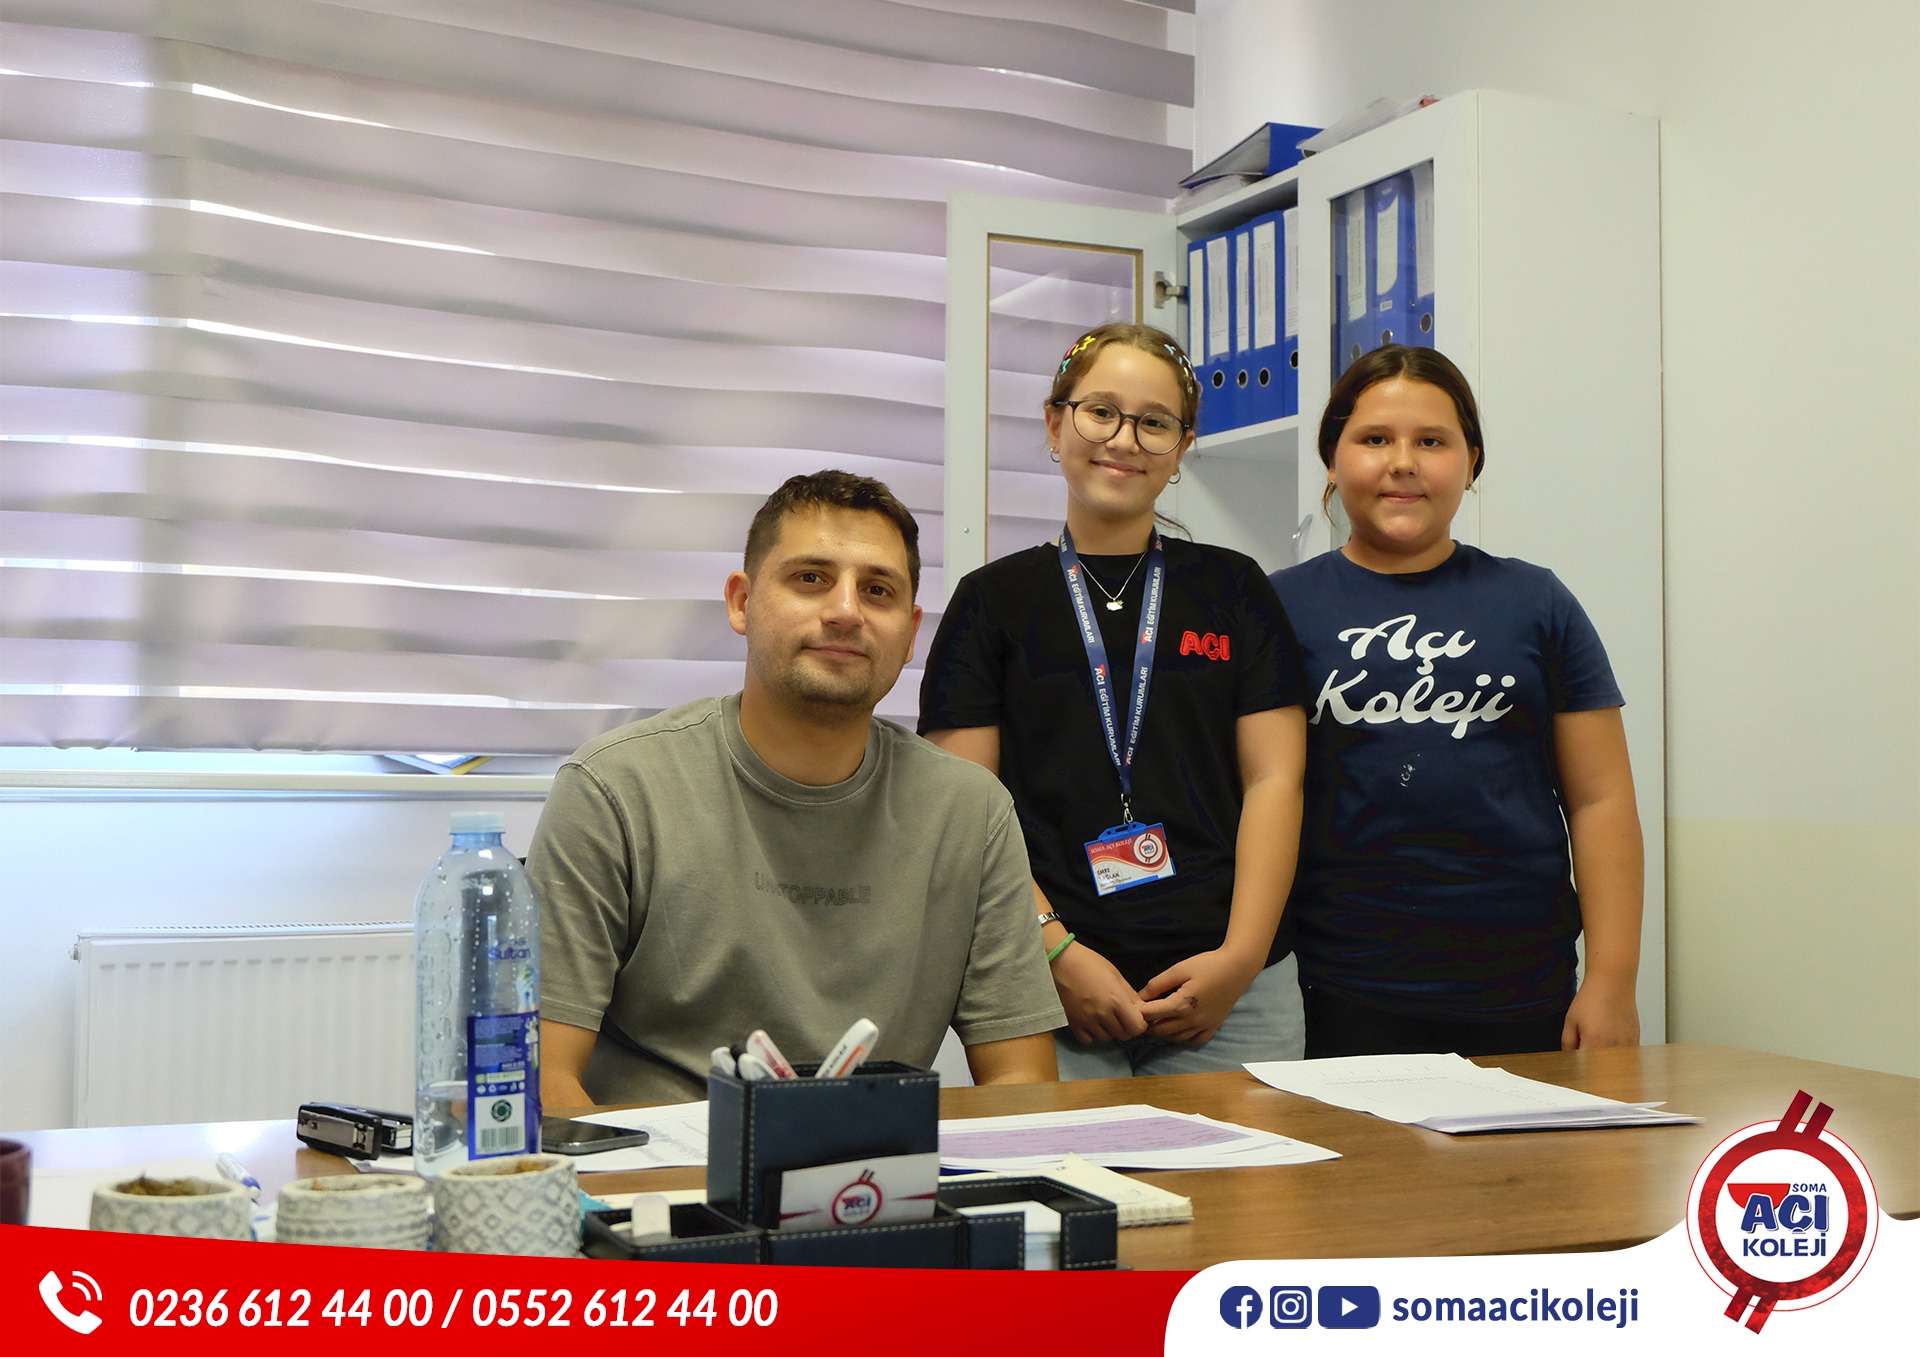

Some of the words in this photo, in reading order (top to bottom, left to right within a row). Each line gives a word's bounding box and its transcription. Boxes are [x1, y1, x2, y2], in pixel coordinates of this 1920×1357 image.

[1150, 566, 1161, 602] KURUMLARI
[1078, 604, 1095, 644] KURUMLARI
[1135, 666, 1149, 716] KURUMLARI
[1309, 669, 1516, 739] Koleji
[1105, 717, 1121, 766] KURUMLARI
[755, 872, 871, 906] UTOPPABLE
